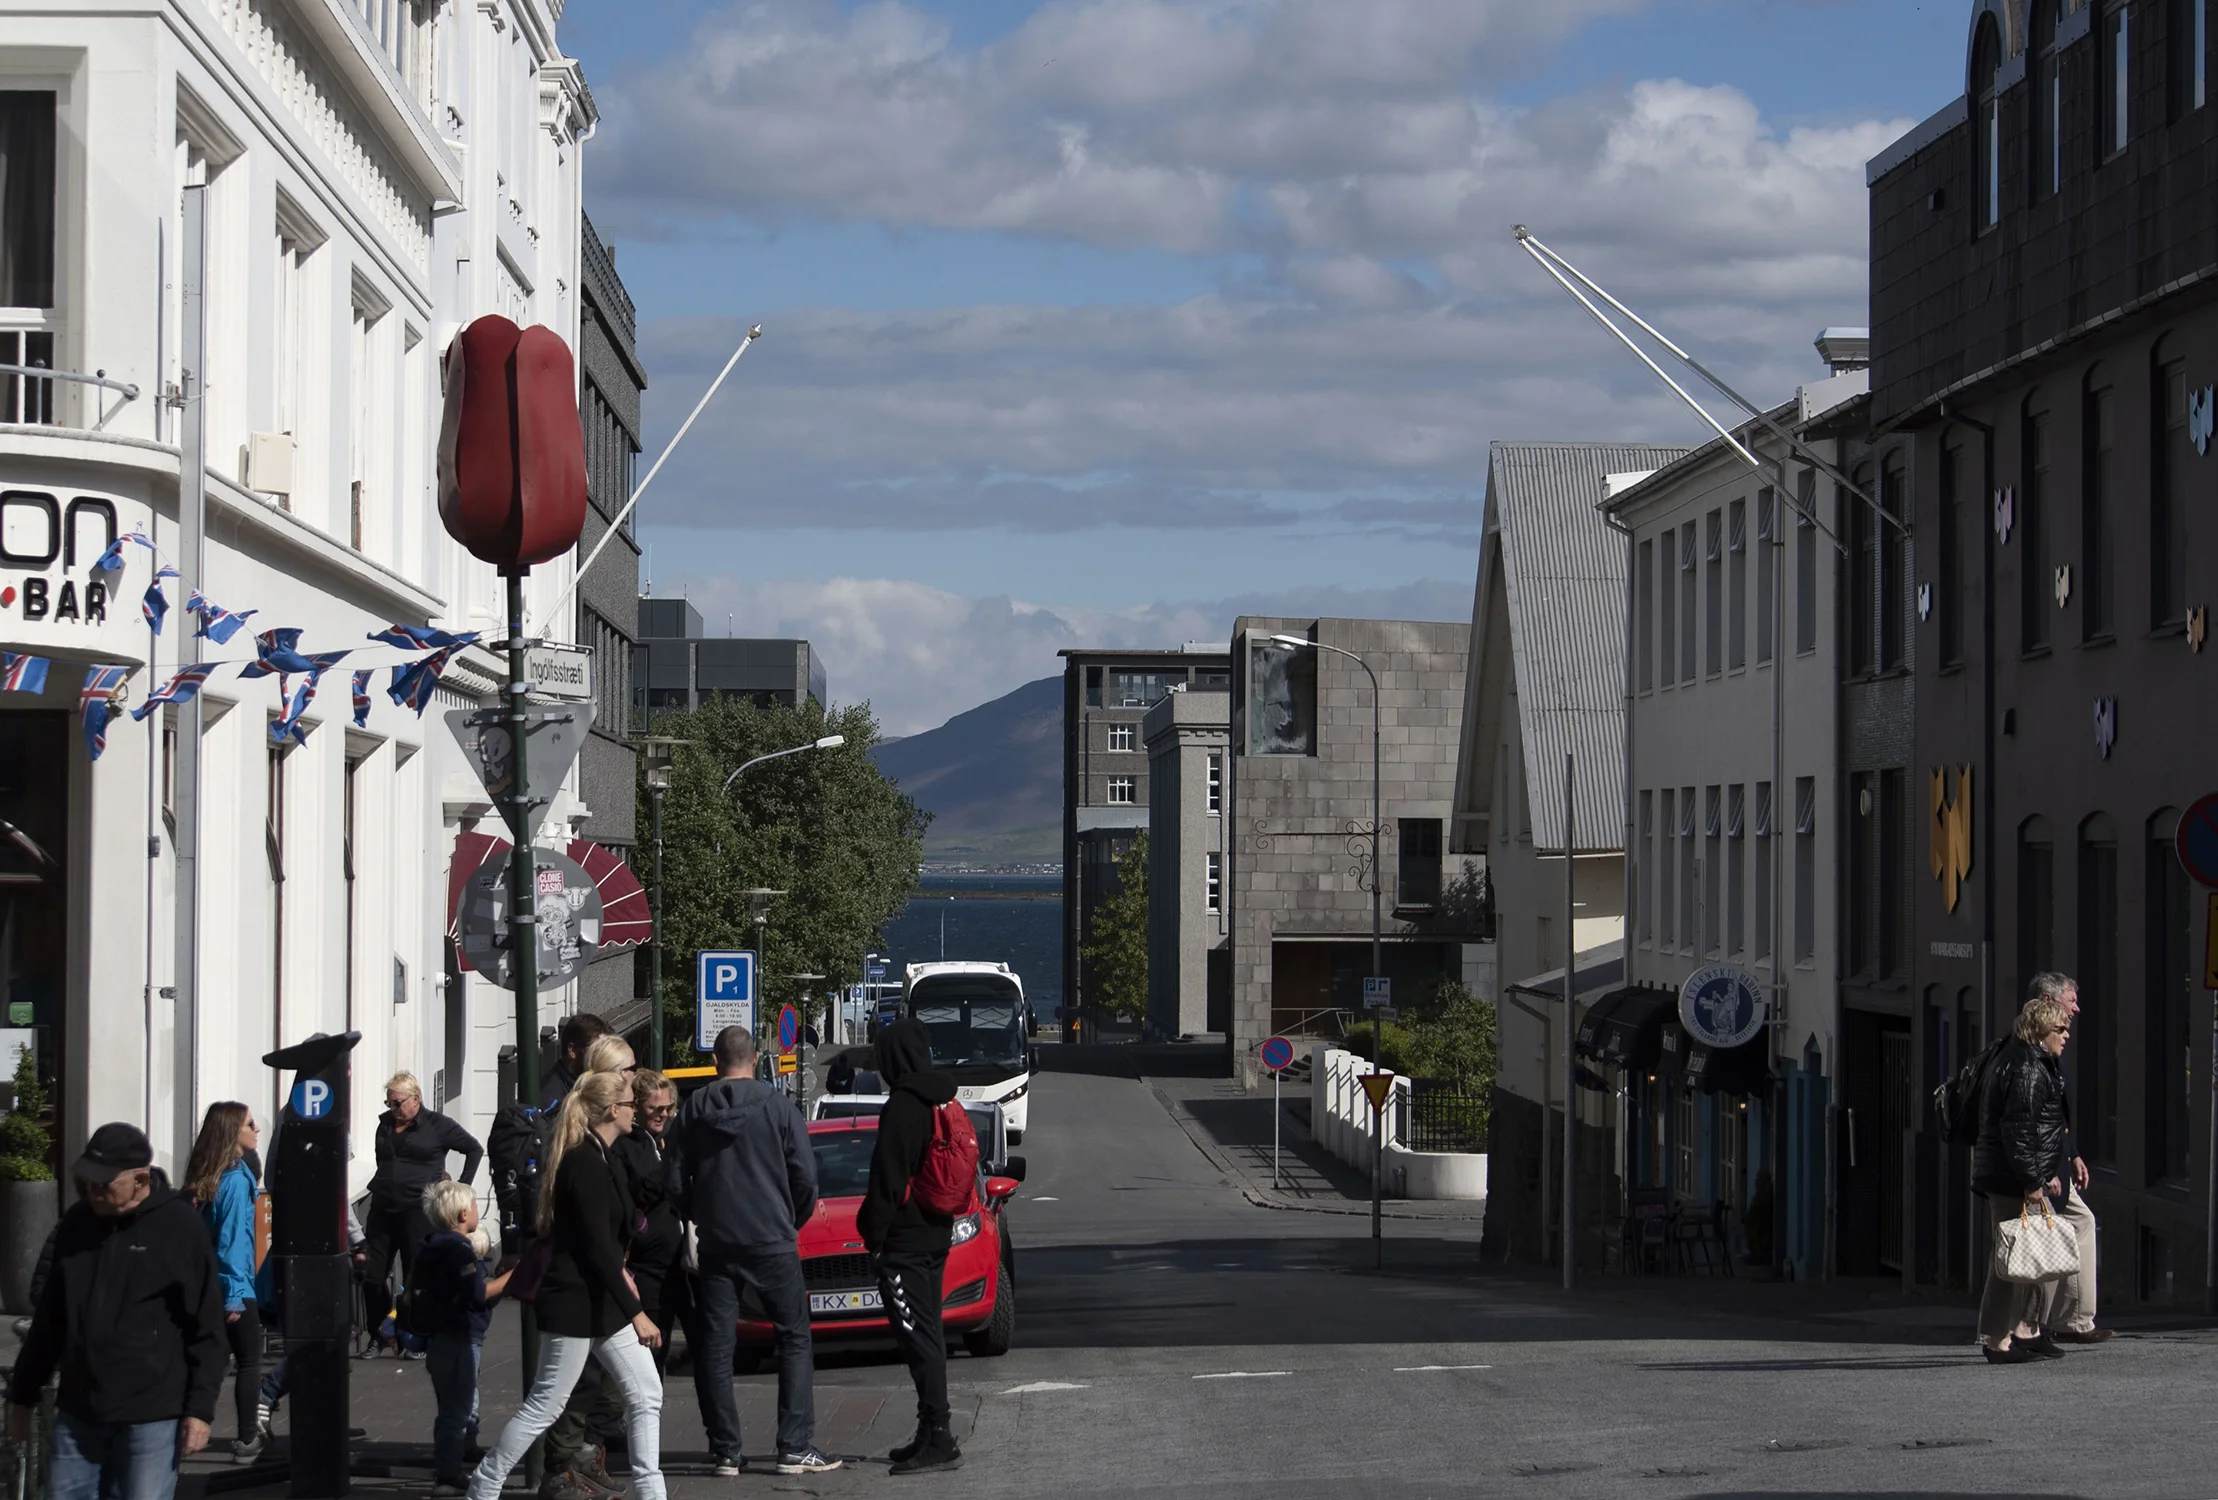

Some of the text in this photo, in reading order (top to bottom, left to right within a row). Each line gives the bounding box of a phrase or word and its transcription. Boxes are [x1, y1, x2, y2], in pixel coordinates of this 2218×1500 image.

[24, 577, 106, 624] BAR
[529, 656, 583, 685] Ingólfsstræti
[539, 872, 562, 882] CLONE
[540, 882, 562, 893] CASIO
[1739, 973, 1762, 1004] BARINN
[823, 1294, 848, 1309] KX
